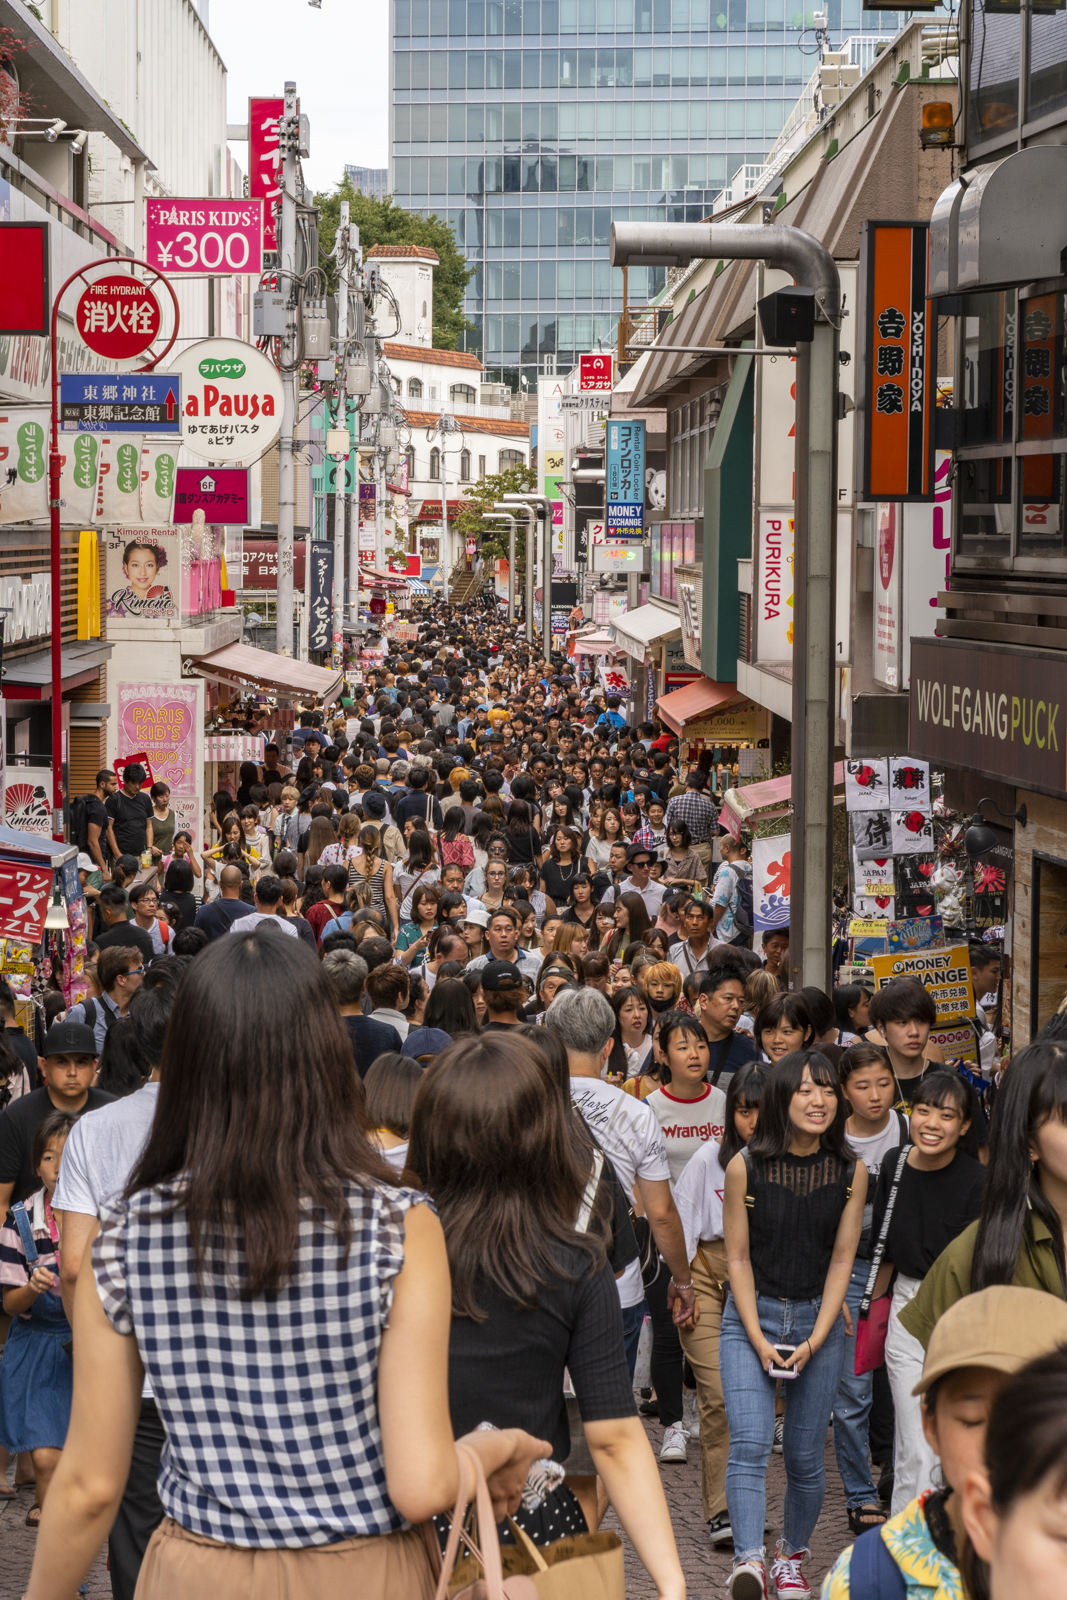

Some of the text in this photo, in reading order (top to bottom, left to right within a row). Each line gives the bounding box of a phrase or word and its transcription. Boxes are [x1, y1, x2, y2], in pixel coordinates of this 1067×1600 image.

[159, 205, 251, 226] PARIS KID'S
[157, 231, 250, 269] ¥300
[90, 285, 147, 296] FIRE HYDRANT
[83, 300, 155, 334] 消火栓
[83, 385, 157, 401] 東郷神社
[587, 381, 612, 389] アガサ
[204, 385, 275, 420] Pausa
[83, 405, 161, 422] 東郷記念館
[188, 424, 260, 434] ゆであげパスタ
[620, 427, 631, 500] コインロッカー
[633, 426, 641, 501] Rental Coin Locker
[202, 481, 214, 490] 6F
[608, 505, 642, 517] MONEY
[608, 518, 642, 526] EXCHANGE
[116, 528, 178, 536] Kimono Rental
[136, 536, 158, 546] Shop
[764, 519, 782, 621] PURIKURA
[111, 588, 174, 616] Kimono
[140, 608, 174, 616] TOKYO
[311, 595, 331, 650] ハセガワ
[132, 707, 185, 724] PARIS
[917, 679, 1060, 752] WOLFGANG PUCK
[136, 724, 181, 741] KID'S
[204, 742, 242, 751] ccessory
[136, 750, 178, 763] 300
[20, 825, 49, 833] TOKYO
[862, 869, 887, 877] JAPAN
[0, 918, 42, 936] ZE
[905, 955, 952, 972] MONEY
[661, 1121, 724, 1141] Wrangler
[893, 1153, 909, 1182] FABULOUS
[879, 1185, 899, 1240] FABULOUS SNAZZY
[864, 1264, 879, 1295] FABULOUS
